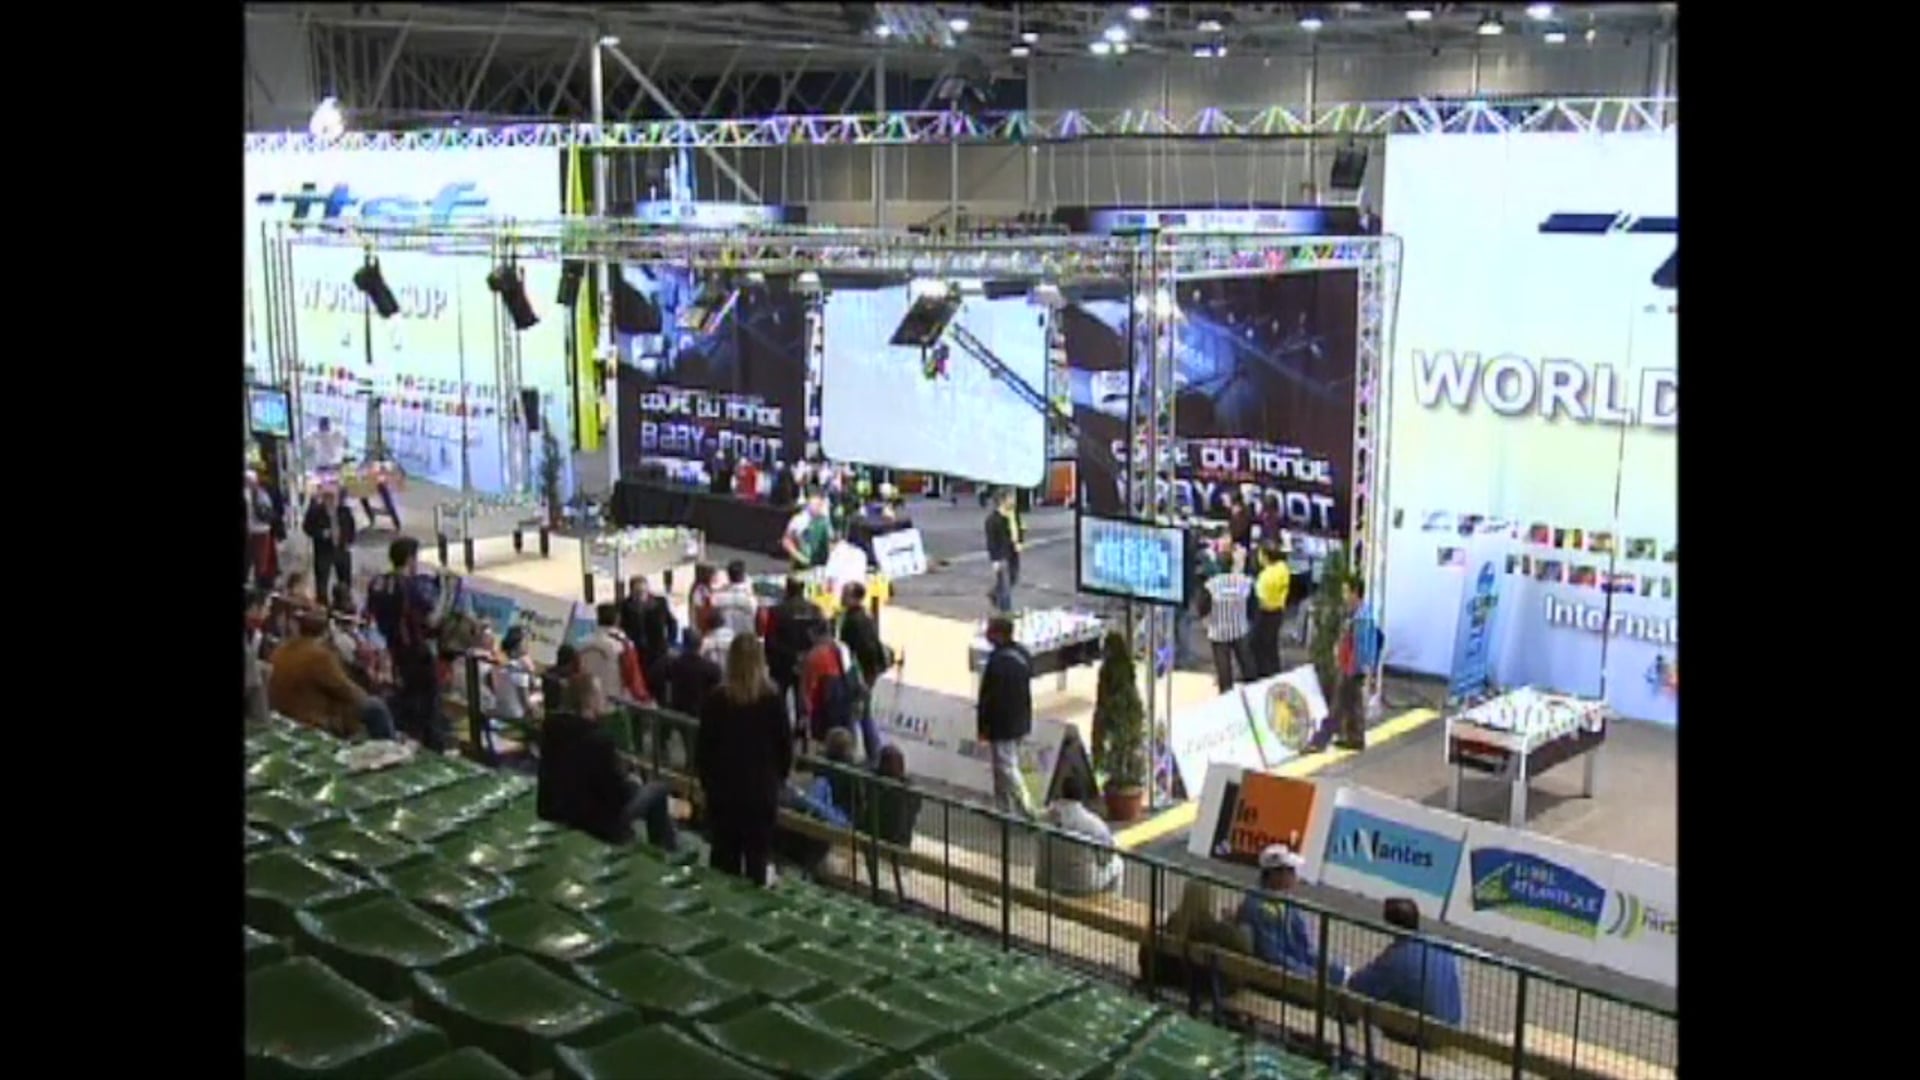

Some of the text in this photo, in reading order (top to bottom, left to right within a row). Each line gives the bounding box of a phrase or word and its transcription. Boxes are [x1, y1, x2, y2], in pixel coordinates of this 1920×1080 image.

[400, 283, 448, 319] CUP
[1411, 348, 1677, 428] WORLD
[1202, 447, 1239, 470] DU
[1248, 449, 1331, 484] MONDE
